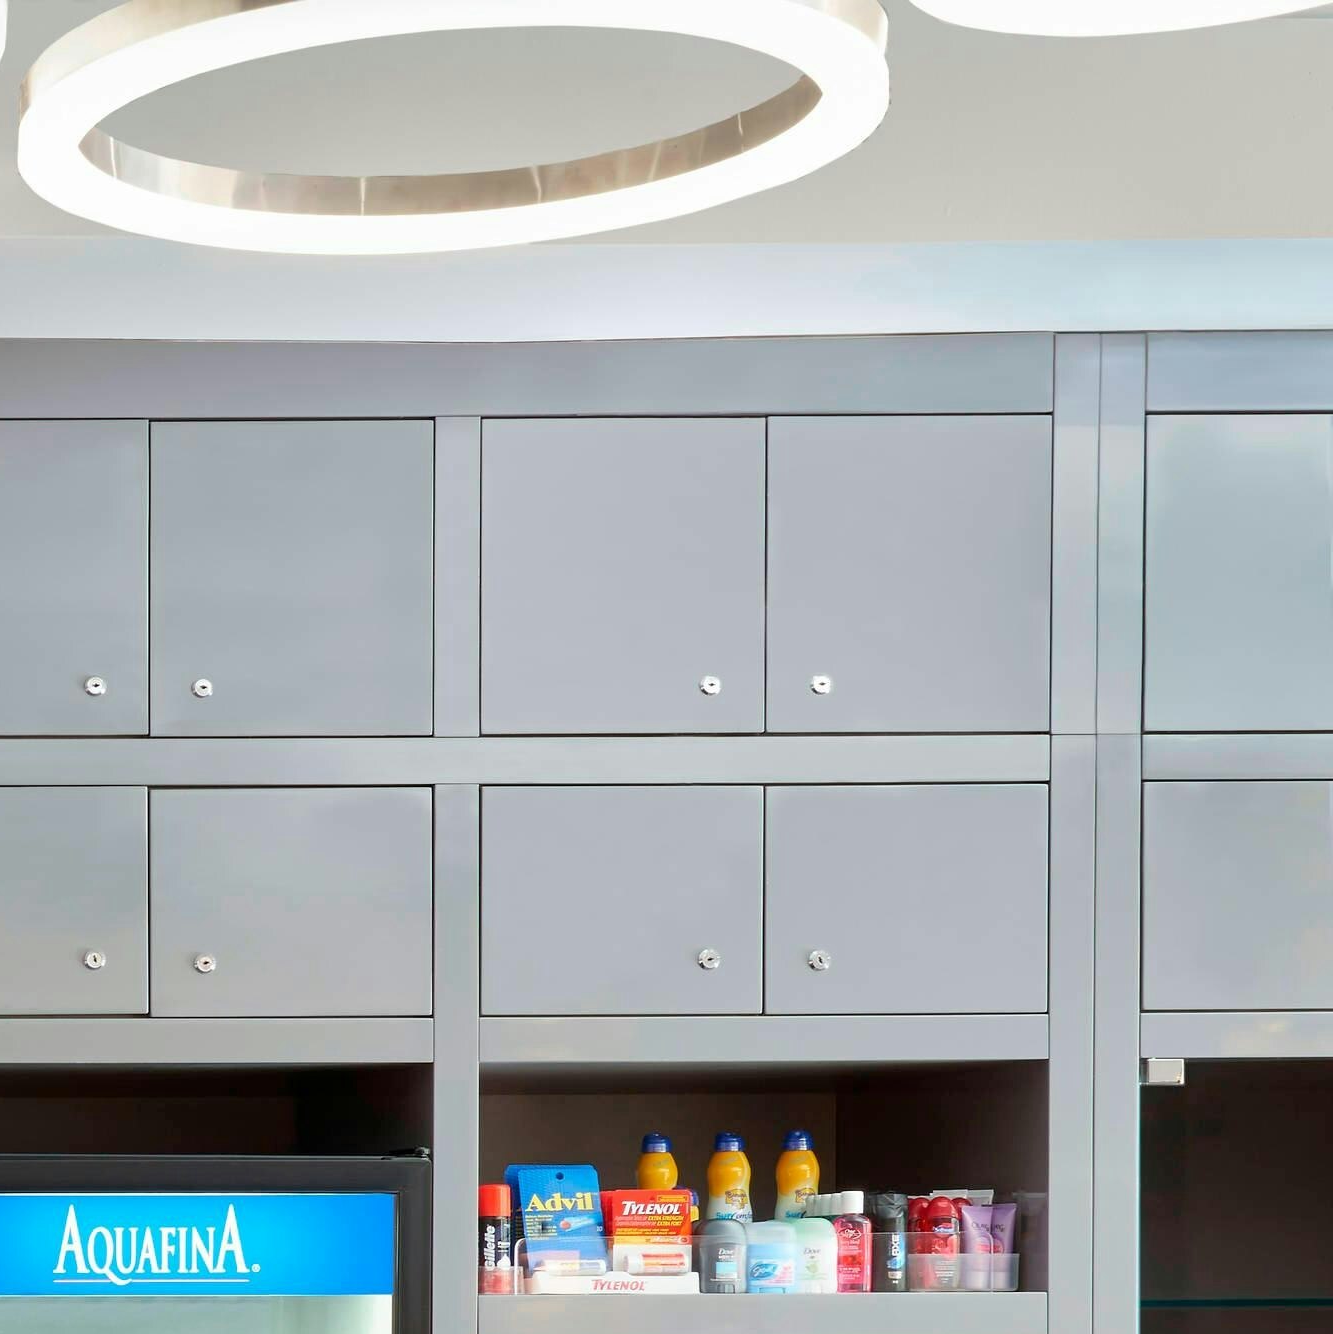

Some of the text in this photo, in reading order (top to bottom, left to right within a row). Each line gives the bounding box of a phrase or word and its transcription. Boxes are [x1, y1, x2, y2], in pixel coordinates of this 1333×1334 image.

[526, 1191, 594, 1211] Advil
[622, 1201, 681, 1215] TYLENOL
[53, 1204, 251, 1286] AQUAFINA
[484, 1225, 496, 1271] Gillette
[592, 1279, 646, 1291] TYLENOL
